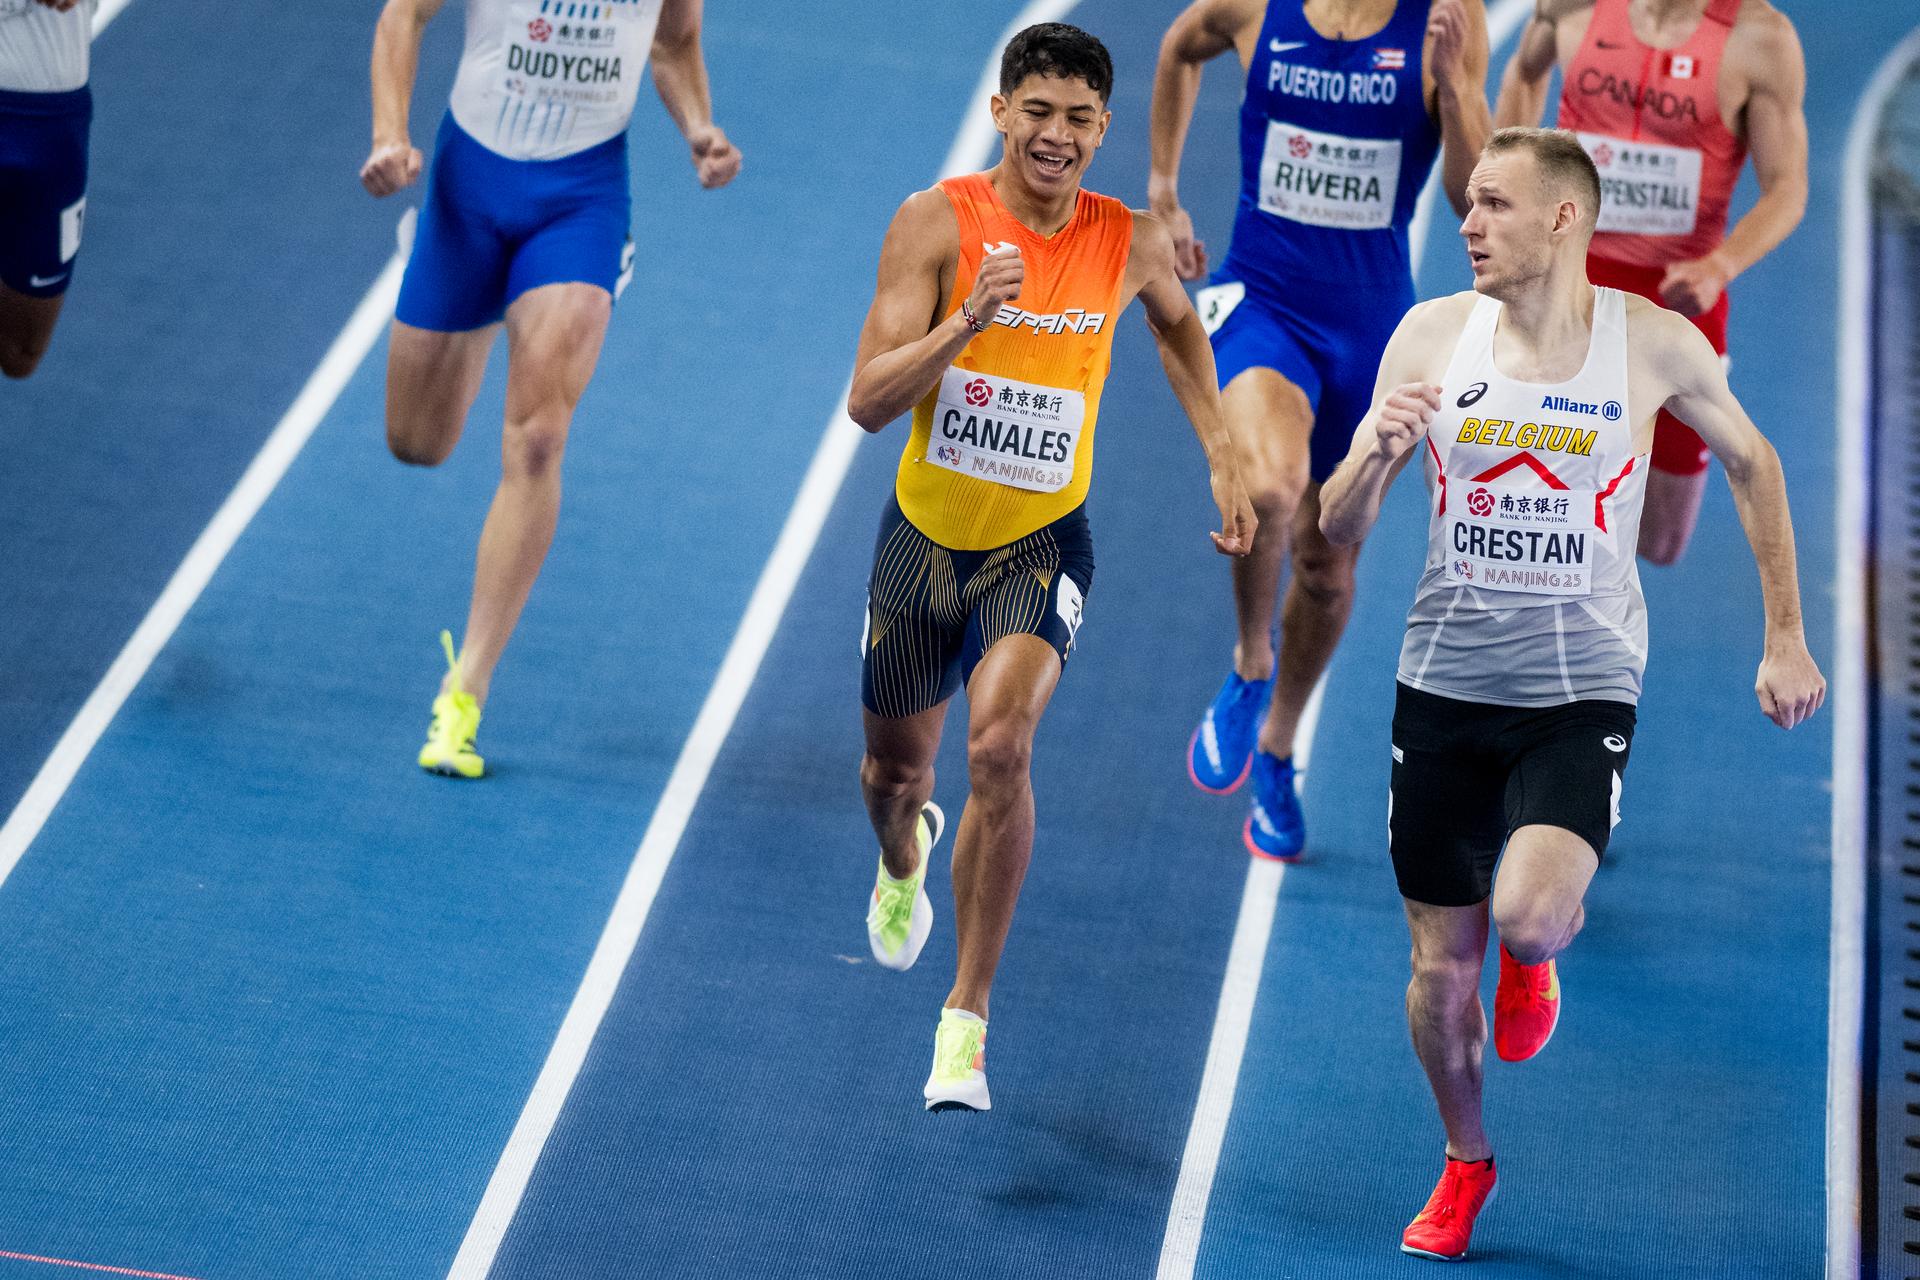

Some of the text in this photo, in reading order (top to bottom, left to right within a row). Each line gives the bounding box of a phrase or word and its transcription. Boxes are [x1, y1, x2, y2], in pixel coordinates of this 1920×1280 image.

[507, 44, 621, 83] DUDYCHA
[1268, 60, 1397, 105] PUERTO RICO
[1578, 67, 1699, 121] CANADA
[1274, 161, 1381, 203] RIVERA
[992, 303, 1107, 336] SPAÑA
[997, 405, 1017, 414] BANK
[1031, 411, 1060, 422] NANJING
[998, 386, 1063, 414] 南京银行
[1541, 396, 1598, 416] Allianz
[942, 409, 1072, 463] CANALES
[1456, 417, 1599, 457] BELGIUM
[972, 456, 1064, 486] NANJING 25
[1500, 494, 1570, 515] 南京银行
[1500, 512, 1568, 524] BANK OF NANJING
[1454, 521, 1585, 564] CRESTAN
[1484, 568, 1582, 588] NANJING 25
